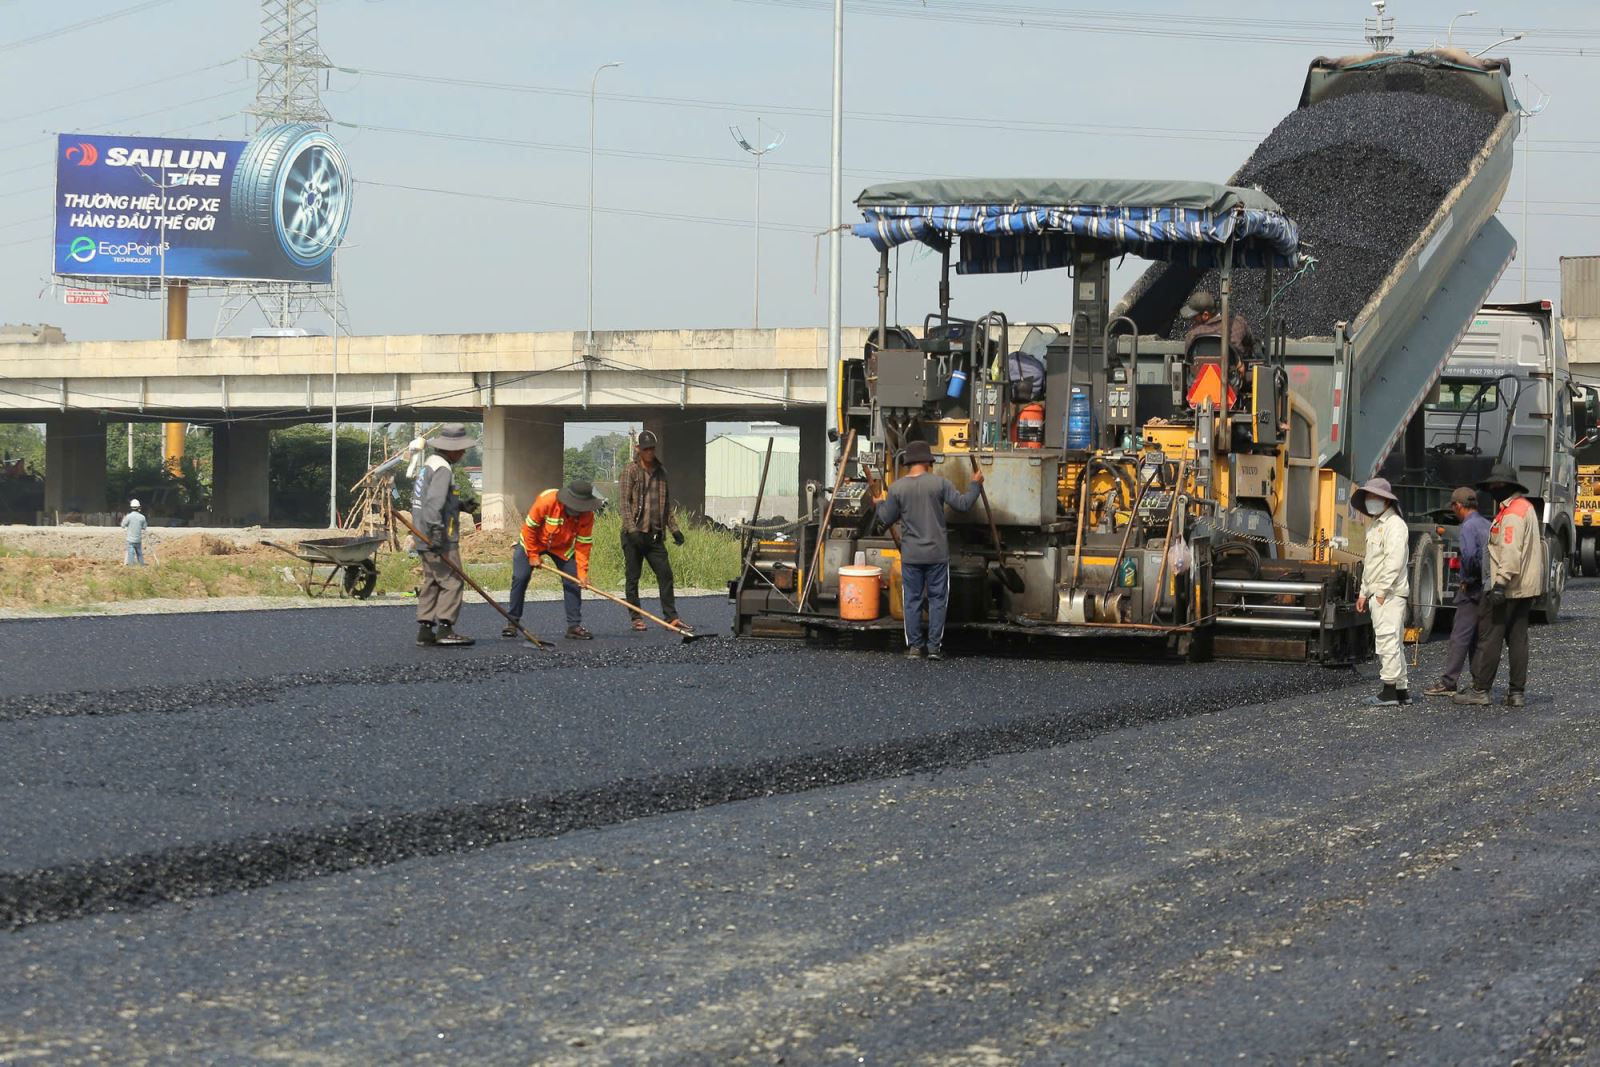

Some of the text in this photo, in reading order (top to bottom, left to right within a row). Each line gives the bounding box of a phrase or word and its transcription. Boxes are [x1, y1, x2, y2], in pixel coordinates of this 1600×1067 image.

[105, 147, 226, 169] SAILUN
[168, 172, 221, 186] TIRE
[64, 193, 220, 213] THƯƠNG HIỆU LỐP XE
[70, 211, 215, 231] HÀNG ĐẦU THẾ GIỚI
